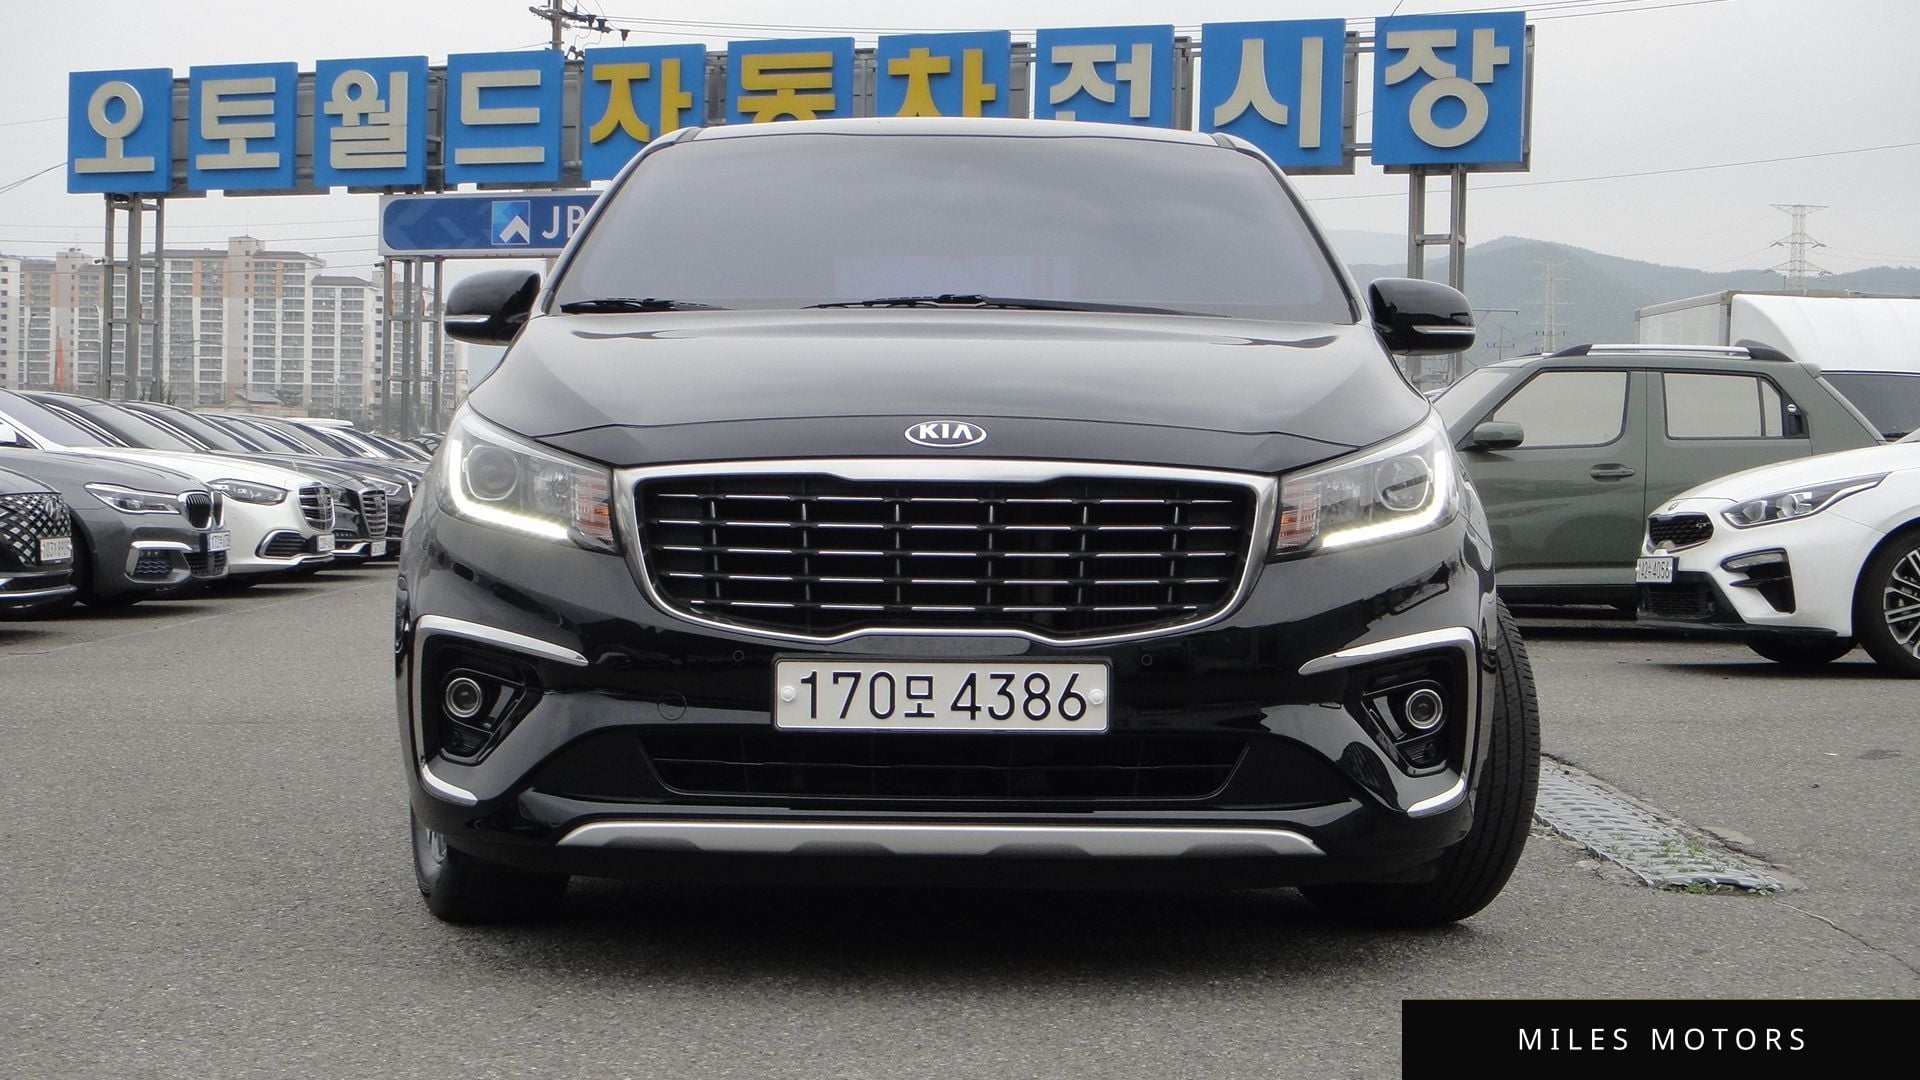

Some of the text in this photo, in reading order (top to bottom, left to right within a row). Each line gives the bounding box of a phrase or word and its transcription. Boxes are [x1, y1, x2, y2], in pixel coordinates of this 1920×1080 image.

[73, 26, 1511, 174] 오토월드 자동차 전시장
[919, 423, 974, 440] KIA
[800, 670, 1087, 722] 170모 4386
